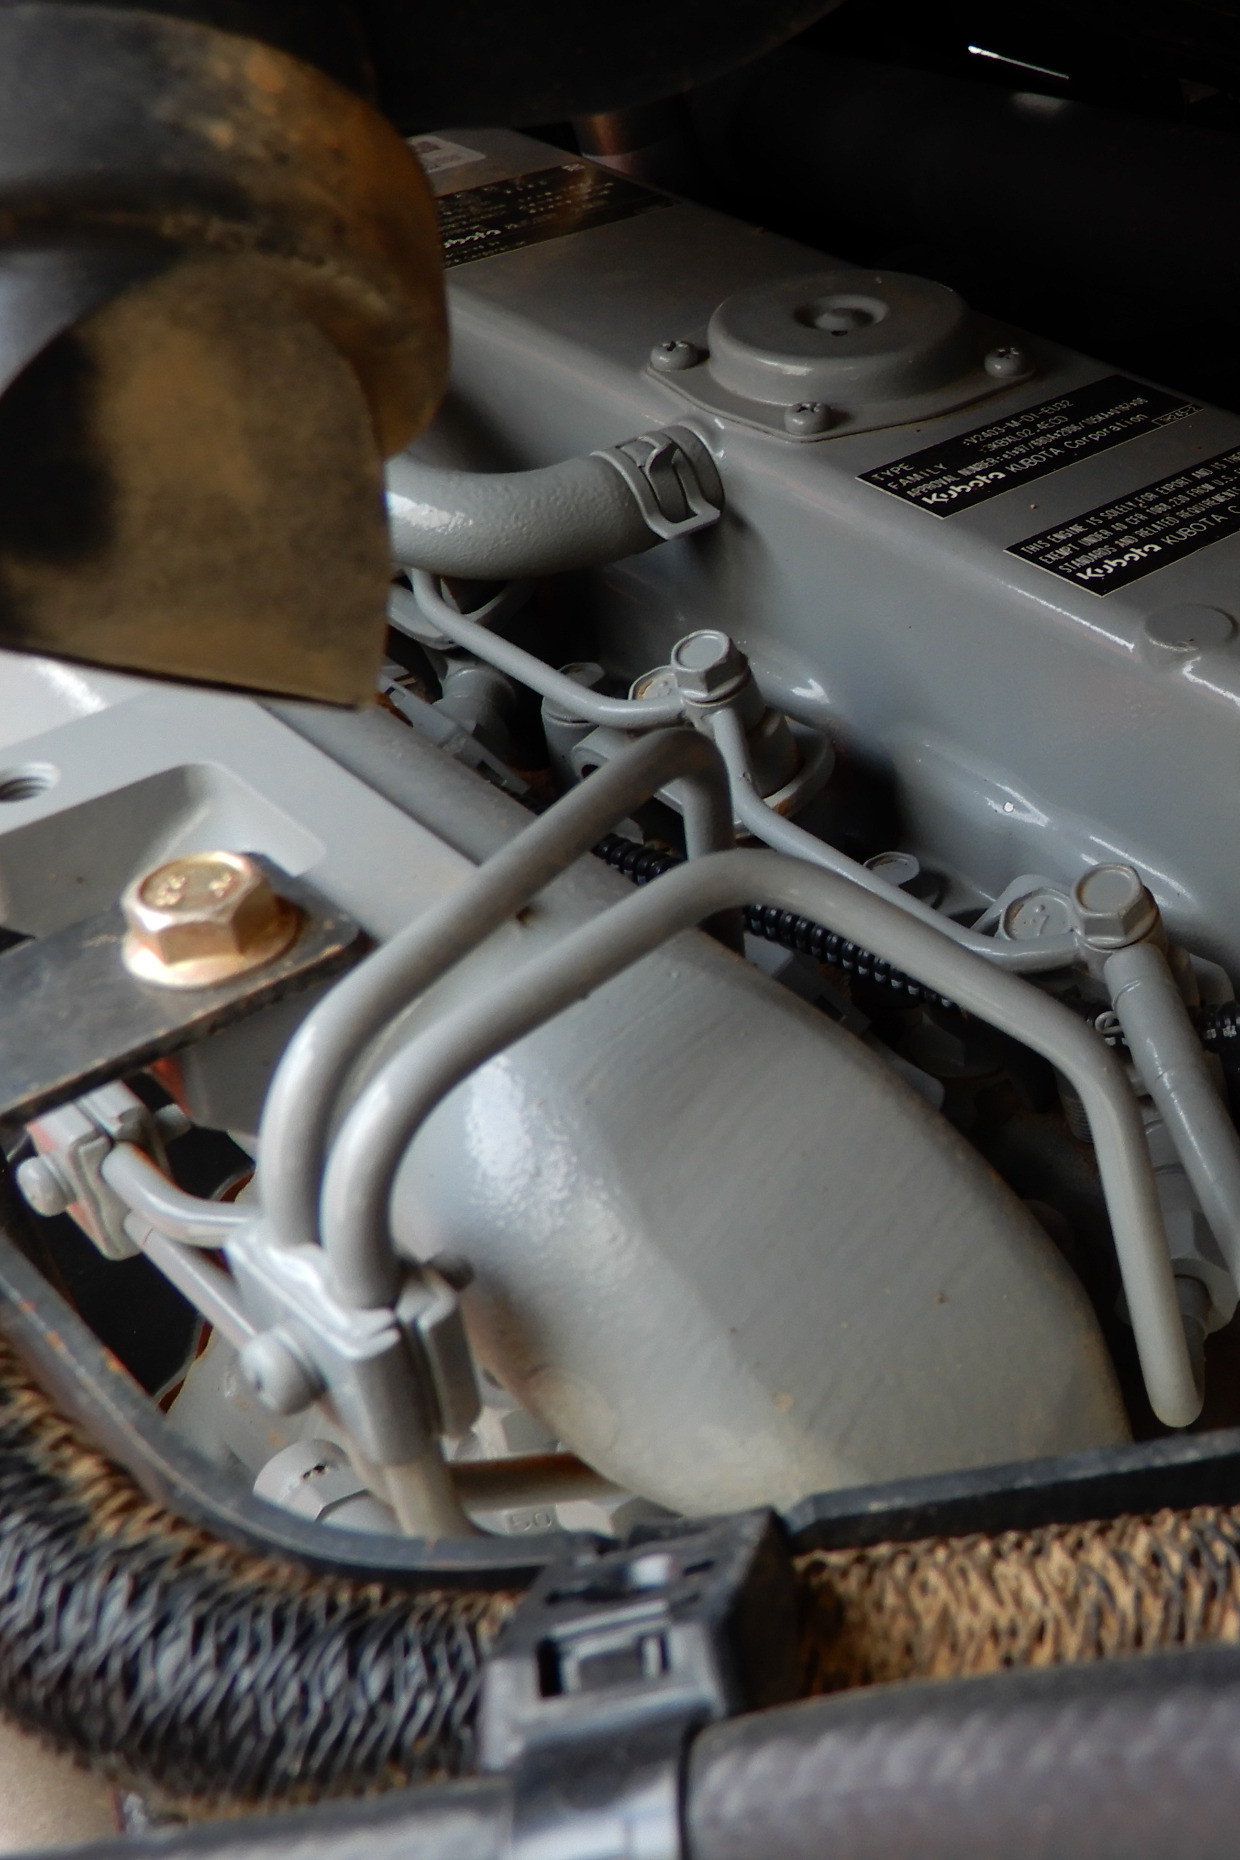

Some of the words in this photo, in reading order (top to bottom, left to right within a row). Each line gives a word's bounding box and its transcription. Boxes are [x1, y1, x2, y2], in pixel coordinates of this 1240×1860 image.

[871, 463, 914, 481] TYPE
[887, 463, 947, 490] FAMILY
[906, 475, 961, 498] APPROVAL
[921, 472, 1006, 504] Kubota
[1005, 448, 1064, 473] KUBOTA
[1064, 414, 1148, 449] Corporation
[1020, 540, 1051, 554] THIS
[1047, 523, 1088, 543] ENGINE
[1085, 517, 1103, 526] IS
[1099, 501, 1141, 520] SOLELY
[1134, 492, 1159, 504] FOR
[1155, 476, 1193, 495] EXPORT
[1191, 468, 1213, 479] AND
[1210, 462, 1227, 470] IS
[1038, 543, 1080, 564] EXEMPT
[1078, 529, 1113, 546] UNDER
[1111, 522, 1128, 531] 40
[1125, 513, 1148, 525] CFR
[1186, 483, 1215, 497] FROM
[1211, 475, 1238, 486] U.S.
[1058, 545, 1117, 573] STANDARDS
[1114, 535, 1139, 548] AND
[1134, 516, 1180, 538] RELATED
[1076, 544, 1162, 580] Kubota
[1160, 514, 1228, 545] KUBOTA
